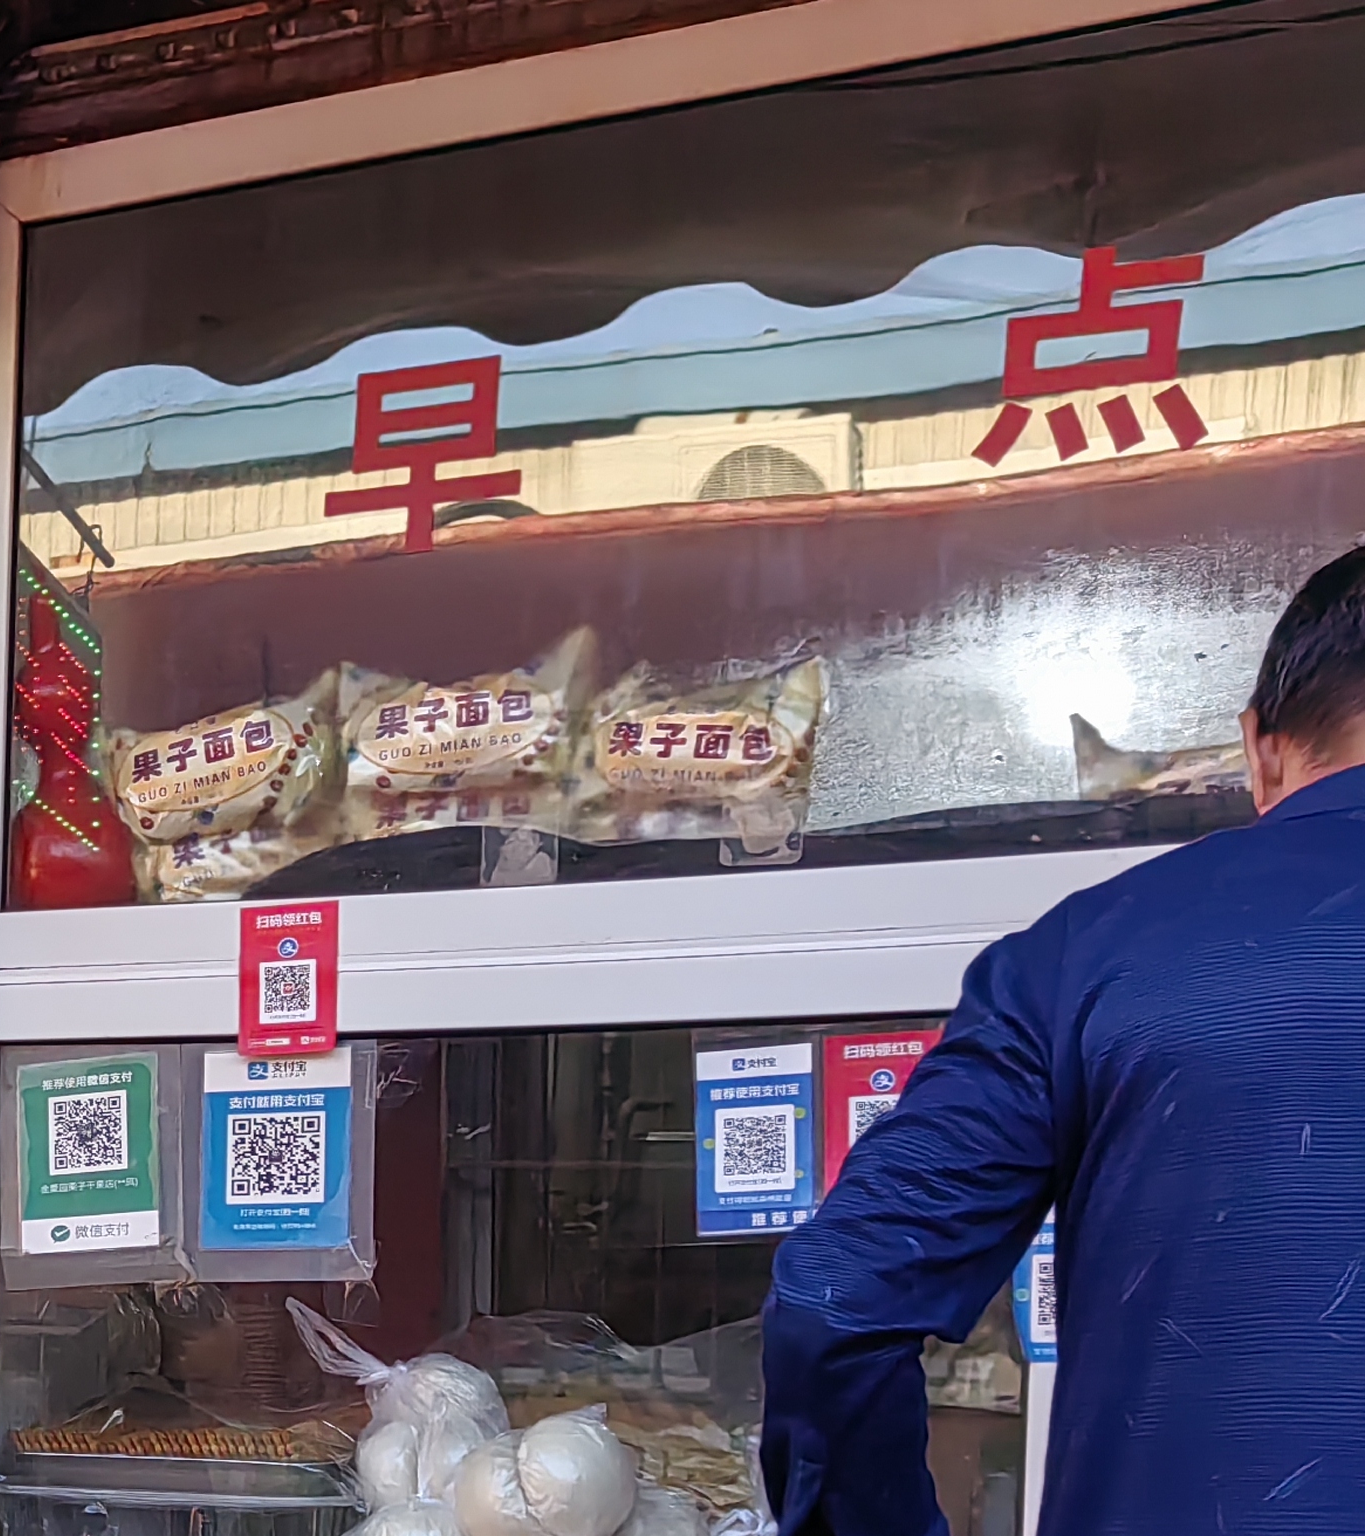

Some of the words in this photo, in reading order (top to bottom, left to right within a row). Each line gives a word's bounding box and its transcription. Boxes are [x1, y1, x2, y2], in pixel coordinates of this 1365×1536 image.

[324, 246, 1210, 553] 早点
[375, 690, 534, 741] 果子面包
[132, 720, 275, 783] 果子面包
[379, 747, 411, 761] GUO
[419, 744, 432, 756] ZI
[440, 738, 481, 755] MIAN
[608, 722, 774, 761] 果子面包
[138, 787, 168, 803] GUO
[174, 783, 187, 794] ZI
[194, 771, 231, 788] MIAN
[238, 761, 267, 778] BAO
[256, 911, 322, 930] 扫码领红包
[844, 1042, 924, 1060] 扫码领红包
[42, 1071, 133, 1092] 推荐使用微信支付
[710, 1084, 799, 1101] 推荐使用支付宝
[752, 1209, 818, 1227] 推荐使
[76, 1223, 129, 1239] 微信支付
